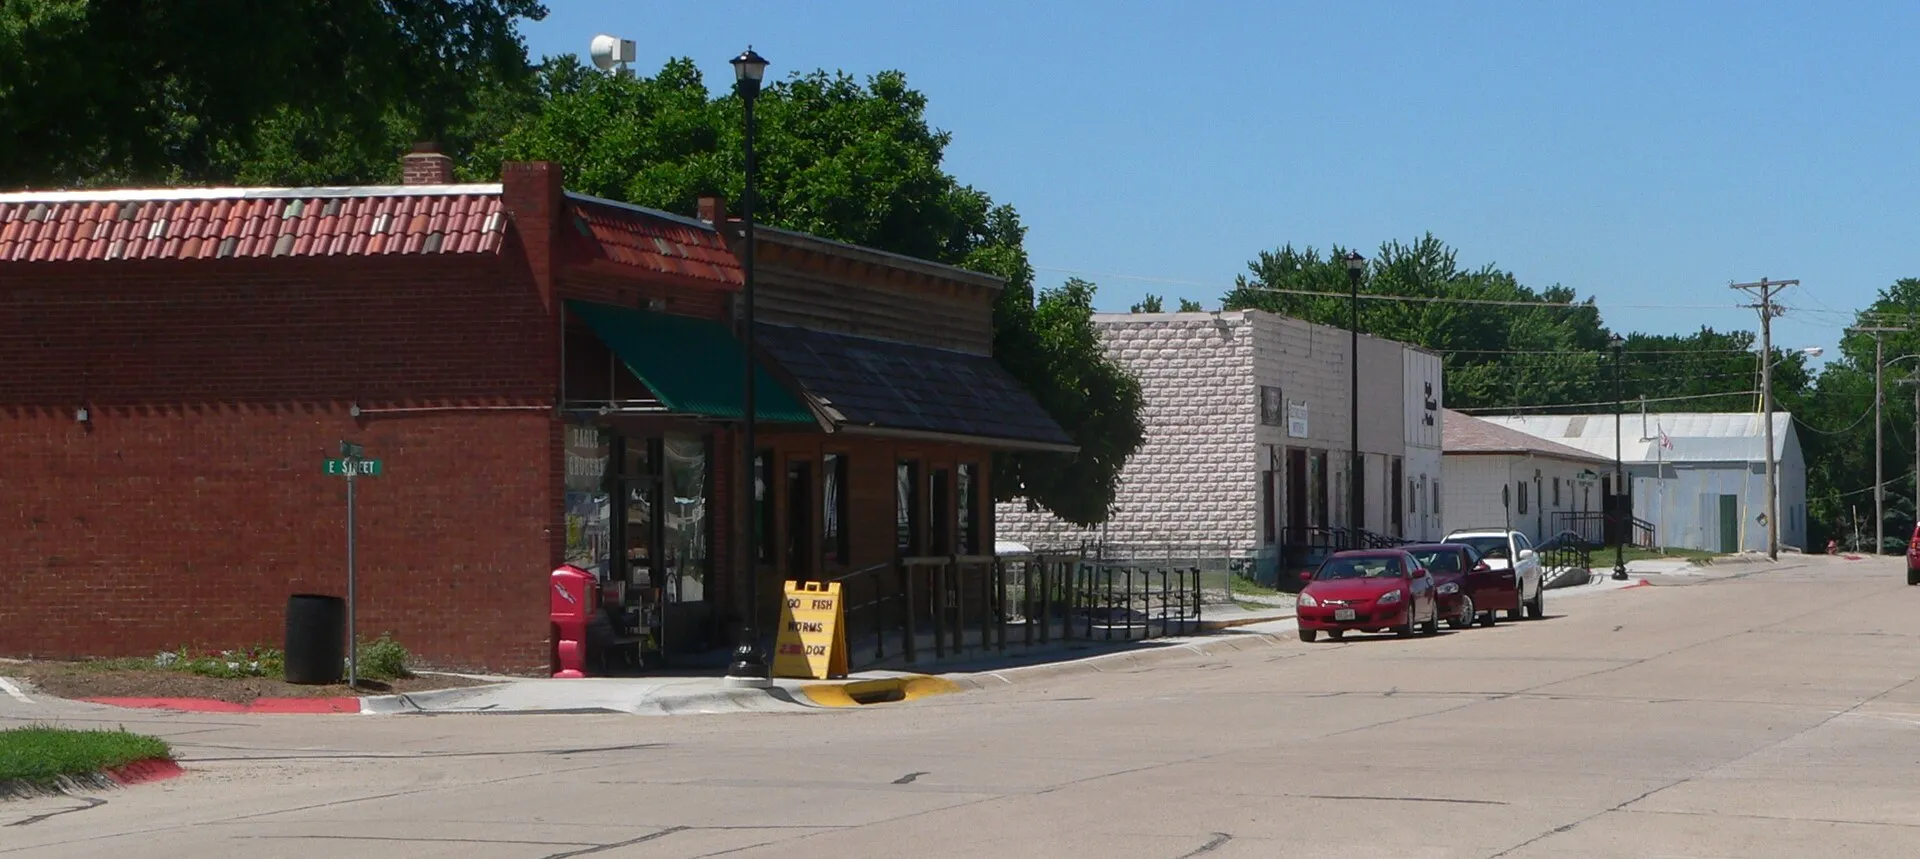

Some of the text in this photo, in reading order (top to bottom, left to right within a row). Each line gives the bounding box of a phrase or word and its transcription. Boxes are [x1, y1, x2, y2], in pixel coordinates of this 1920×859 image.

[574, 428, 599, 448] EAGLE
[329, 461, 374, 473] E STREET
[787, 598, 833, 610] GO FISH
[788, 622, 823, 632] WORMS
[805, 645, 826, 656] DOZ
